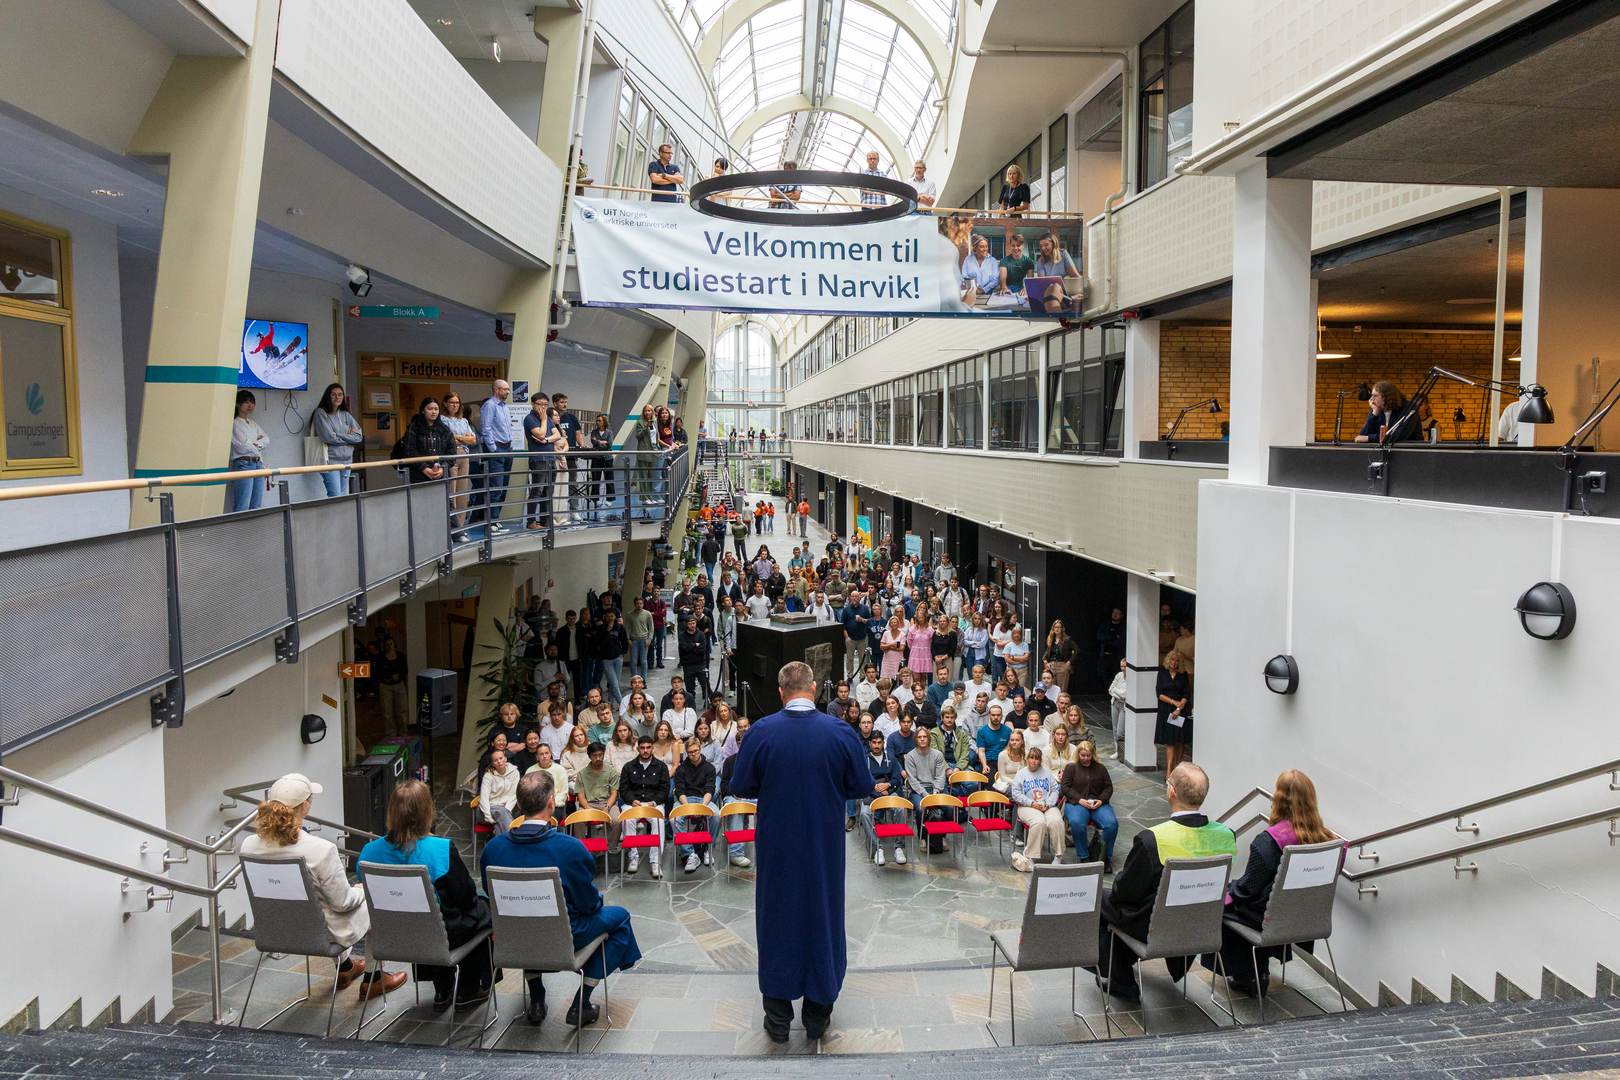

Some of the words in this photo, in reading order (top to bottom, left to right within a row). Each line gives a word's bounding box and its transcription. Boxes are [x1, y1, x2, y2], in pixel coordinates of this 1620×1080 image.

[603, 208, 617, 216] UiT
[619, 209, 648, 219] Norges
[603, 217, 635, 227] arktiske
[636, 220, 678, 230] universitet
[704, 230, 882, 262] Velkommen
[892, 238, 918, 263] til
[622, 266, 792, 296] studiestart
[801, 271, 807, 296] i
[818, 273, 920, 299] Narvik!
[393, 308, 416, 316] Blokk
[418, 308, 425, 316] A
[401, 361, 496, 379] Fadderkontoret
[7, 422, 65, 440] Campustinget
[1023, 777, 1050, 795] BRONCOS
